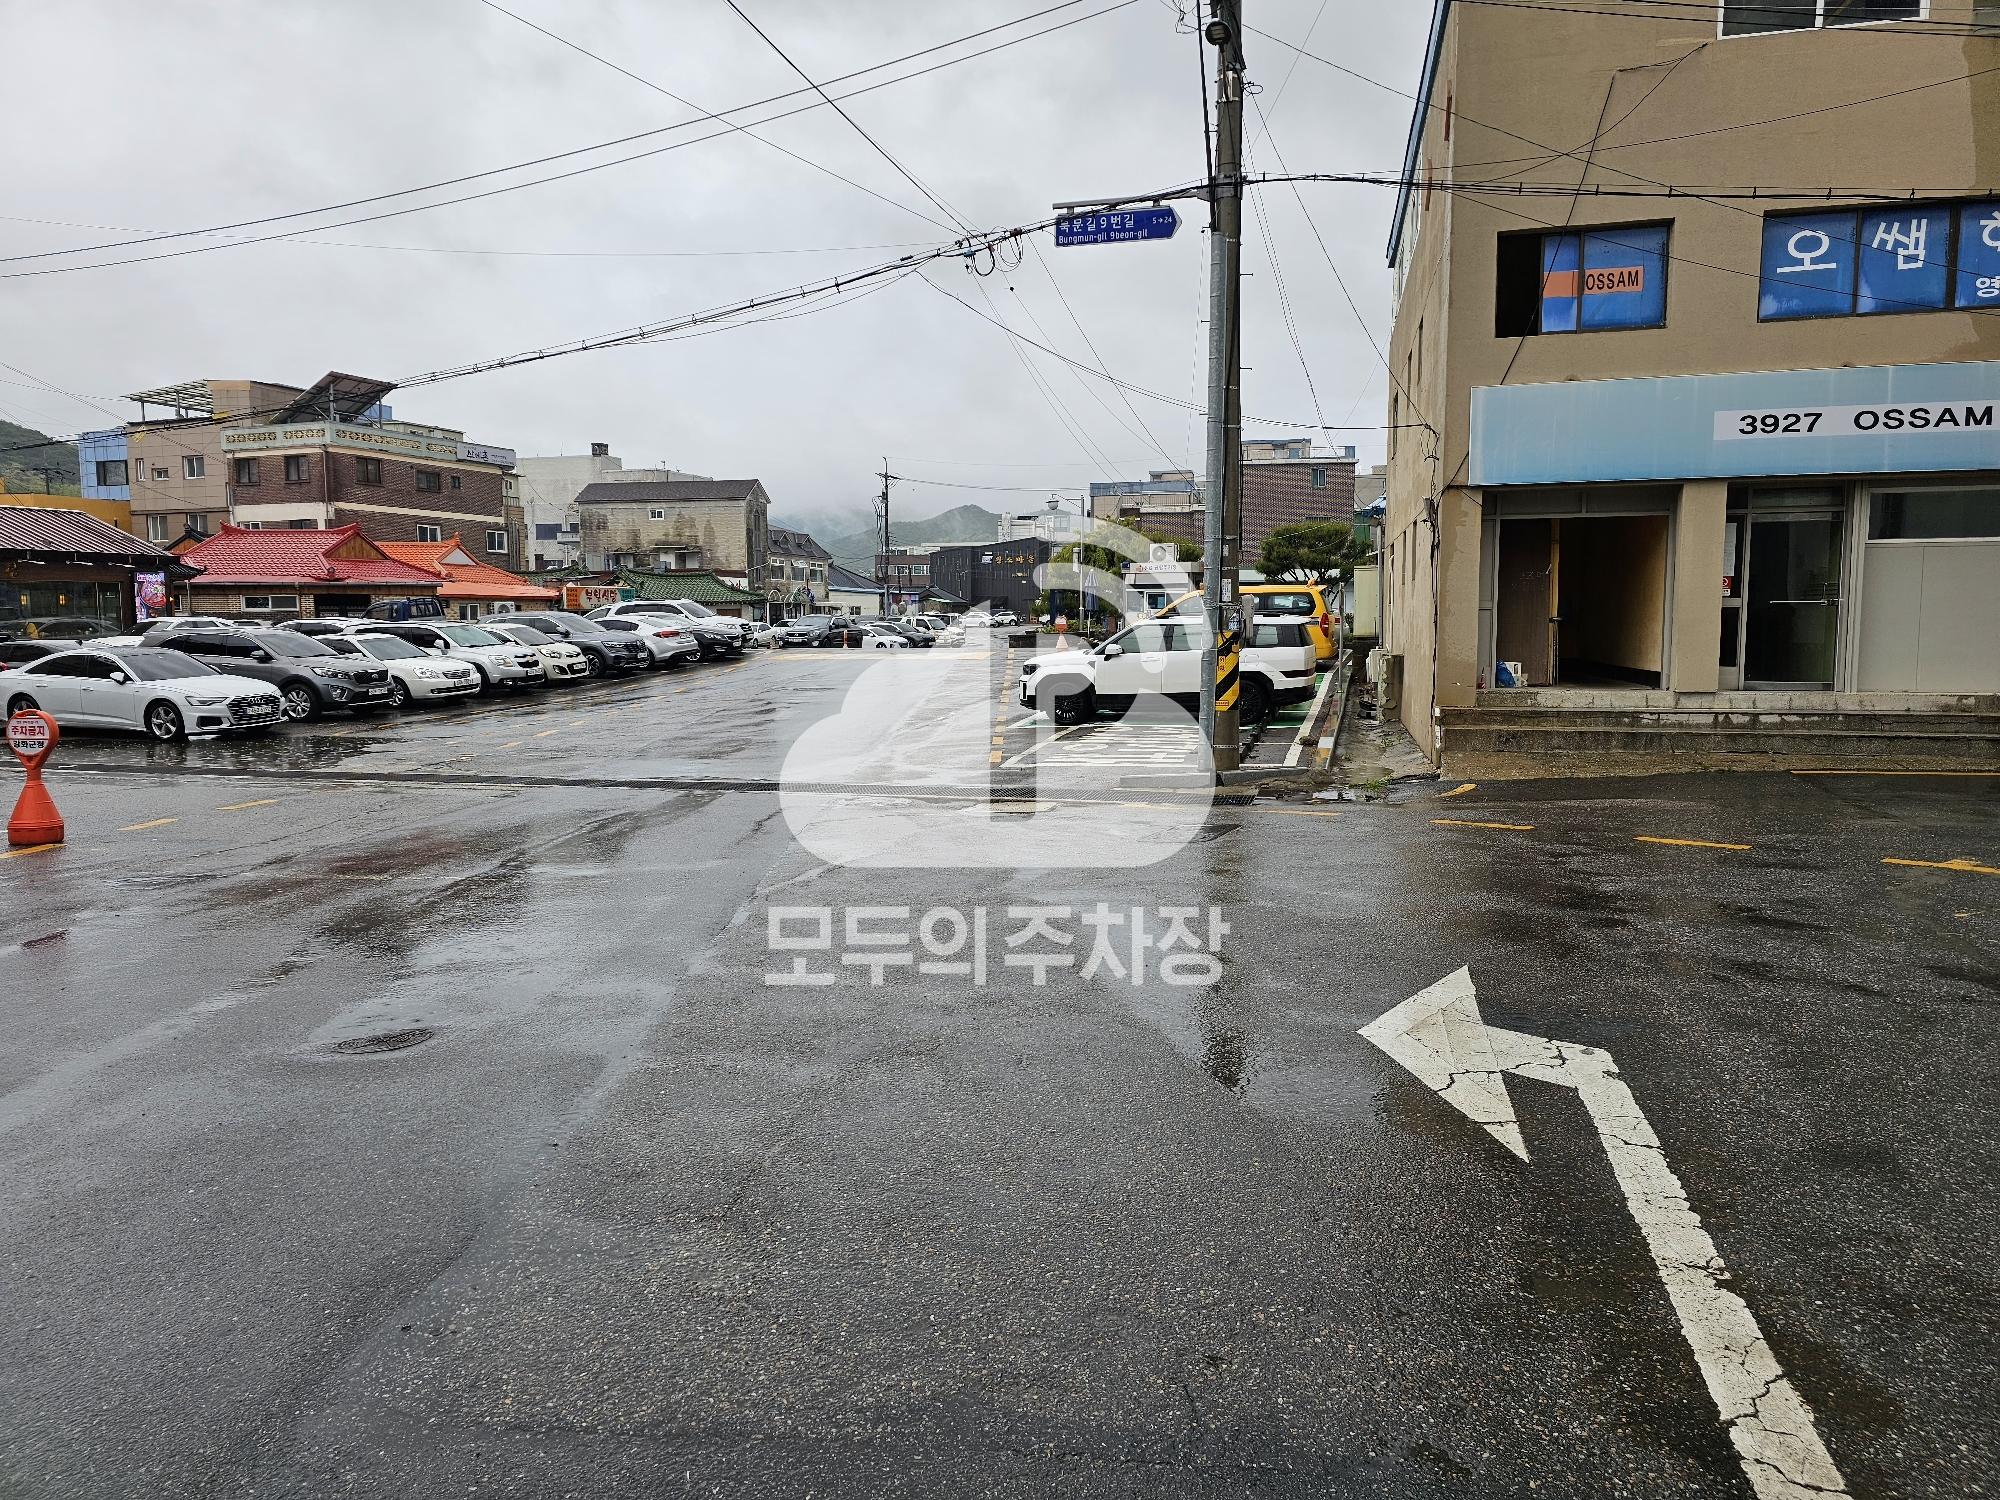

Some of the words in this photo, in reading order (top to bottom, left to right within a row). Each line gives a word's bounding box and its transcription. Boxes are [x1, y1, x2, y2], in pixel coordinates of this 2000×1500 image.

[1059, 233, 1107, 244] Bungmun-gil
[1110, 229, 1148, 240] 9beon-gil
[1585, 269, 1639, 291] OSSAM
[1738, 411, 1823, 435] 3927
[1853, 405, 1994, 431] OSSAM
[11, 725, 45, 736] 주차금지
